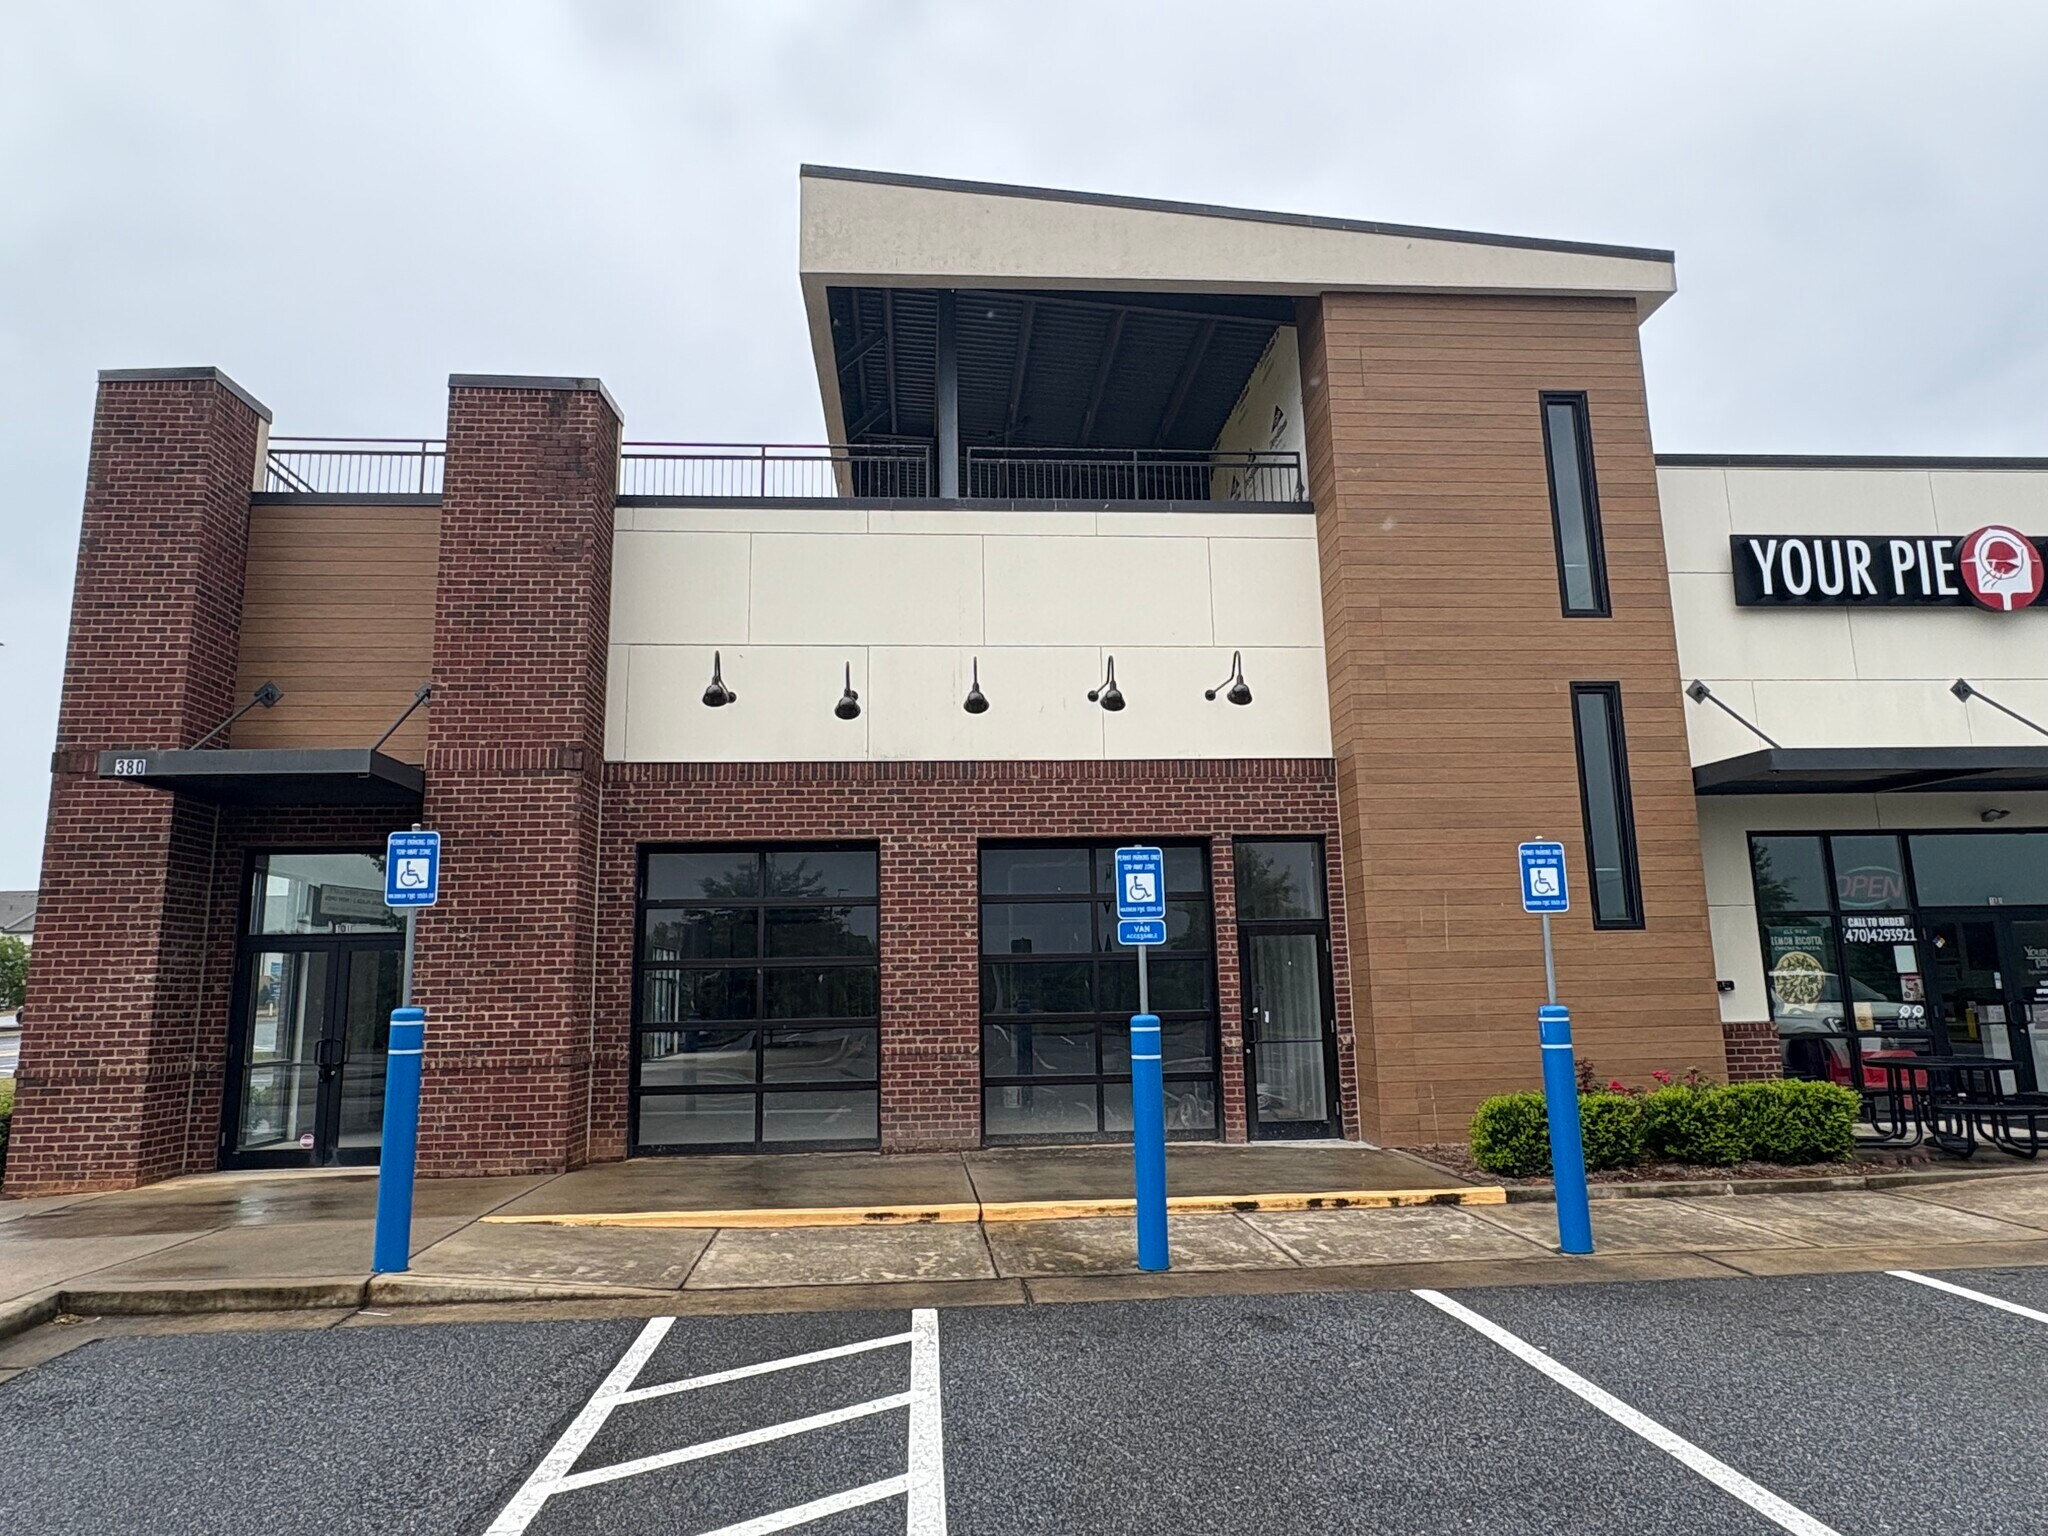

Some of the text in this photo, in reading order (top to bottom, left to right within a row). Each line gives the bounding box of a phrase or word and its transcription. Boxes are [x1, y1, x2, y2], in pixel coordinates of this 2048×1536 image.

[1749, 539, 1959, 595] YOUR PIE
[117, 760, 144, 775] 380
[1838, 875, 1903, 898] OPEN
[1133, 925, 1151, 933] VAN
[1847, 917, 1905, 928] CALL TO ORDER
[1770, 935, 1823, 946] LEMON RICOTTA
[1842, 927, 1917, 944] (470)4293921
